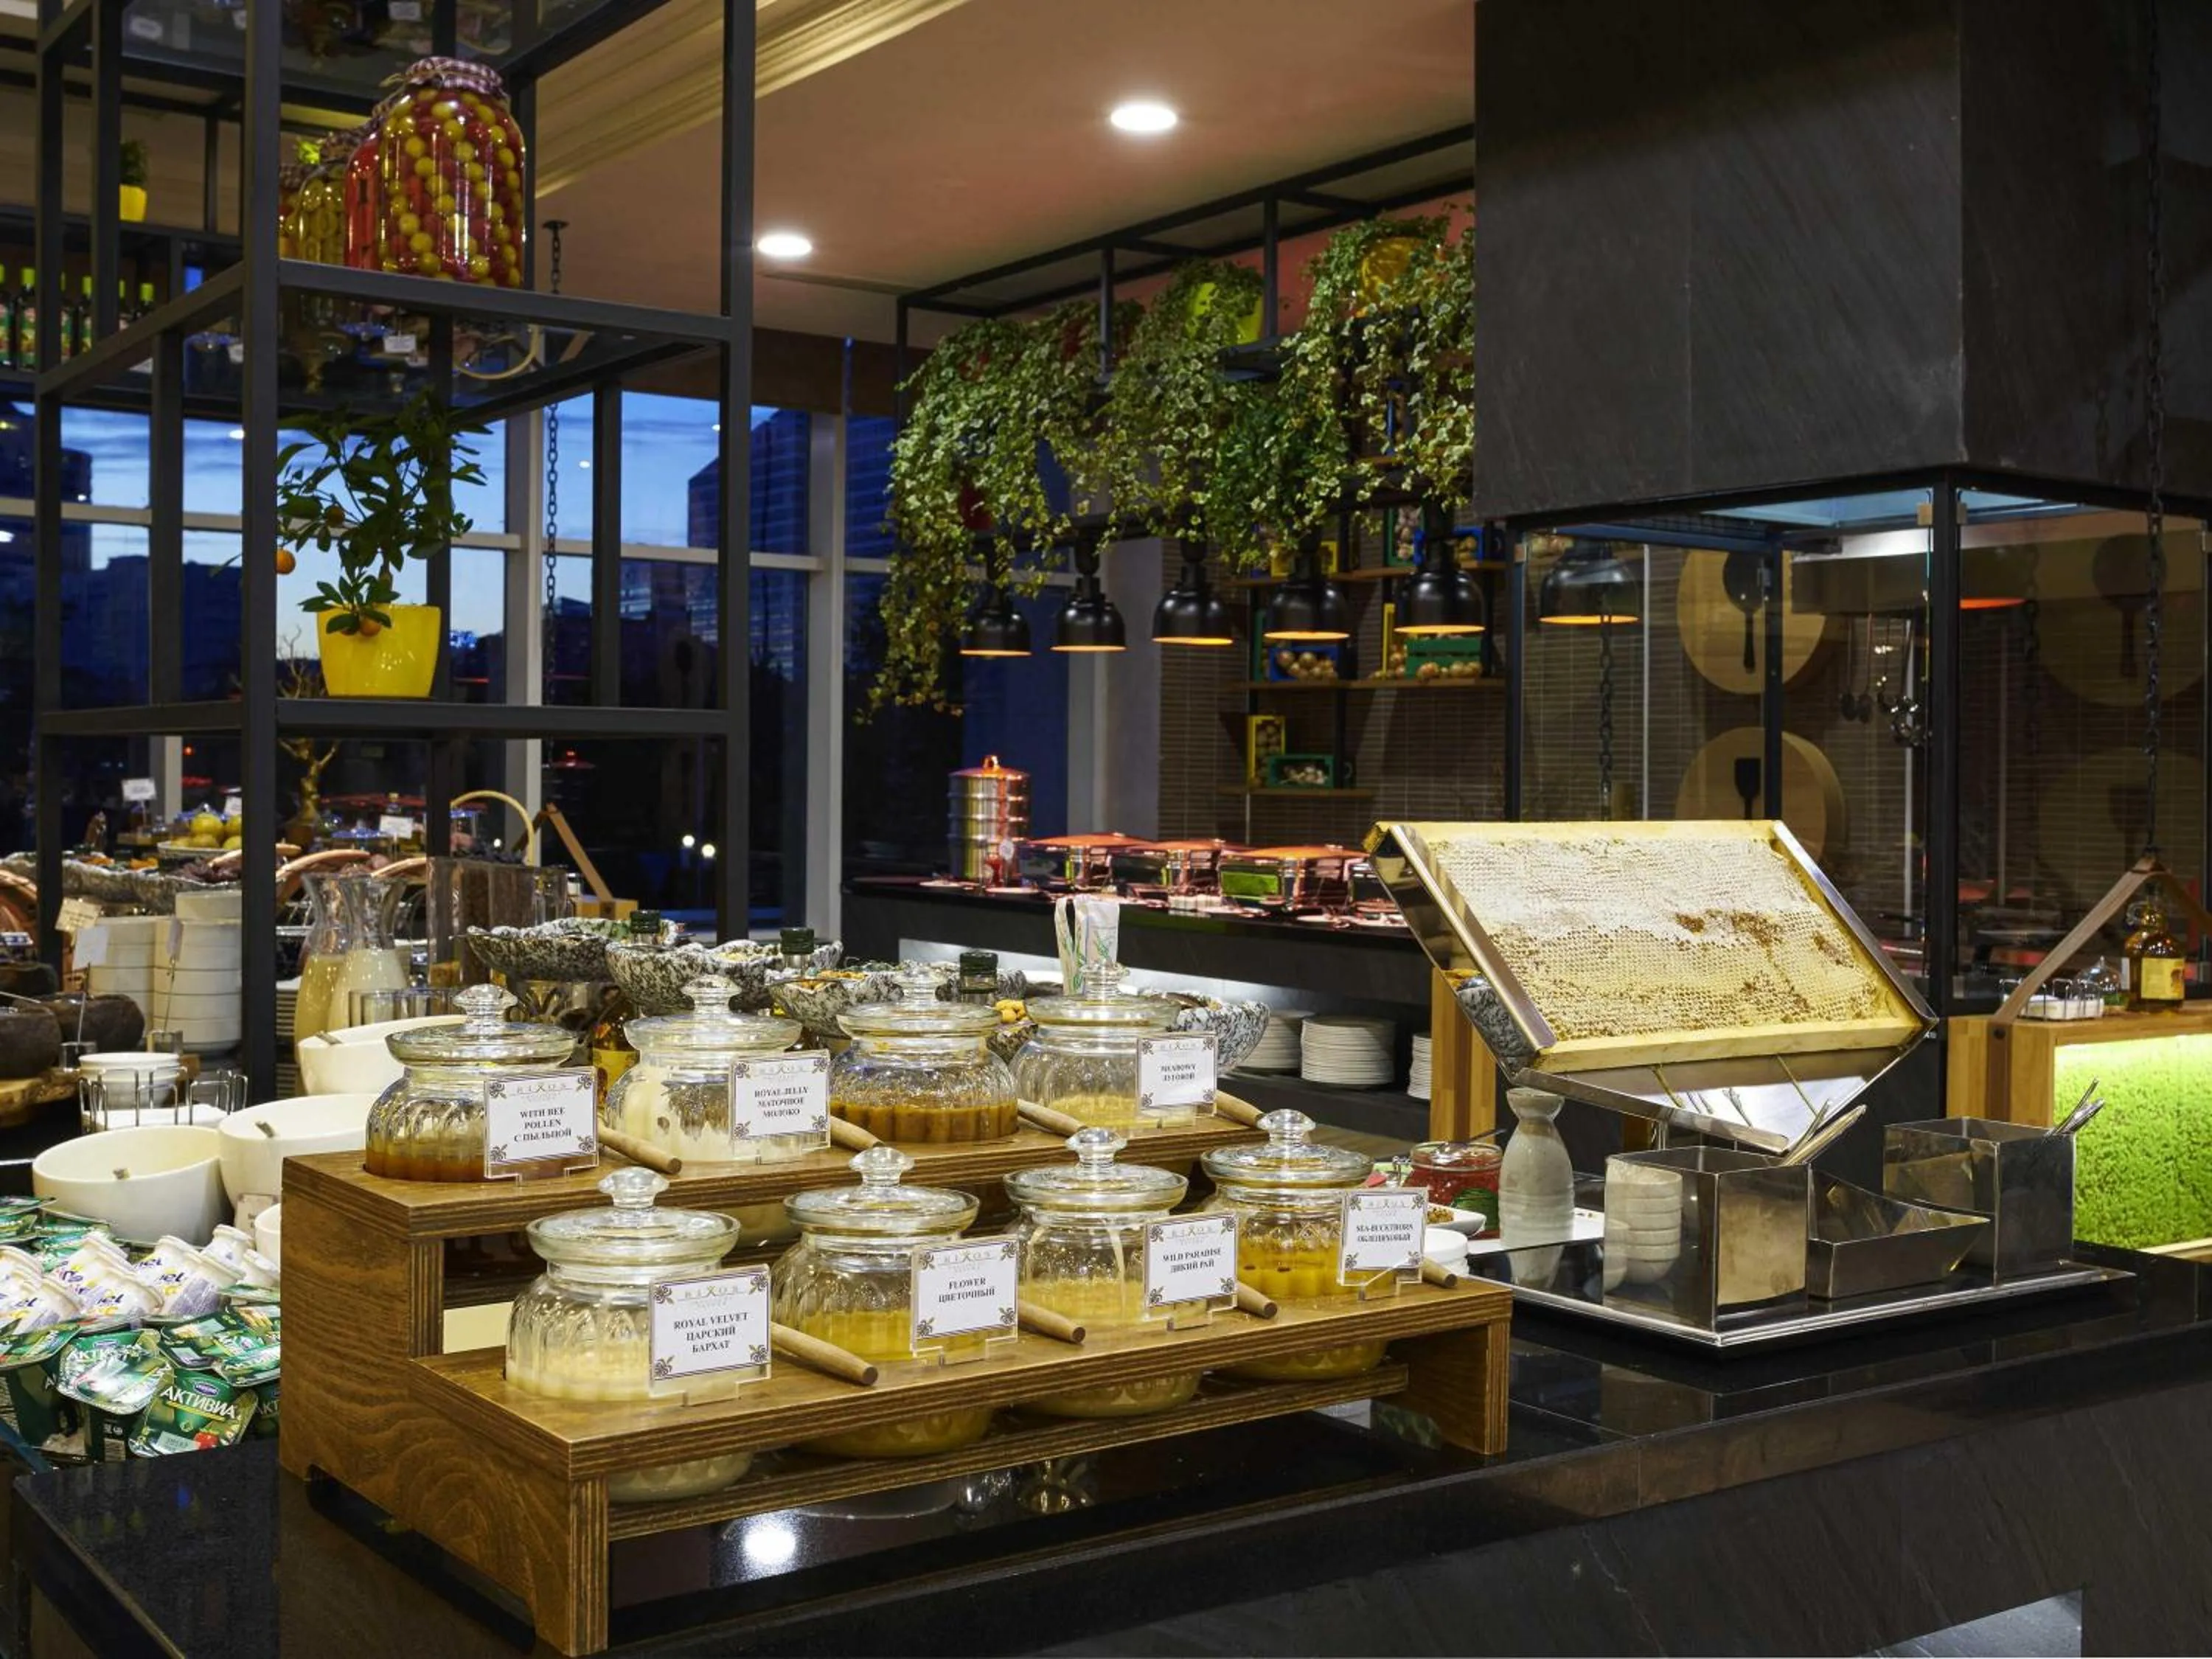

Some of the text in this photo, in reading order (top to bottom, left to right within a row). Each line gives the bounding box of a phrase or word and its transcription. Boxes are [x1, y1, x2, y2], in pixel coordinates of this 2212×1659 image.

[754, 1088, 781, 1098] ROYAL
[520, 1107, 566, 1119] WITH BEE
[524, 1119, 561, 1130] POLLEN
[1163, 1248, 1221, 1262] WILD PARADISE
[948, 1277, 986, 1290] FLOWER
[939, 1286, 995, 1303] ЦВЕТОЧНЫЙ
[674, 1312, 748, 1329] ROYAL VELVET
[686, 1326, 735, 1341] ЦАРСКИЙ
[692, 1340, 730, 1354] БАРХАТ
[159, 1385, 236, 1419] АКТИВИА
